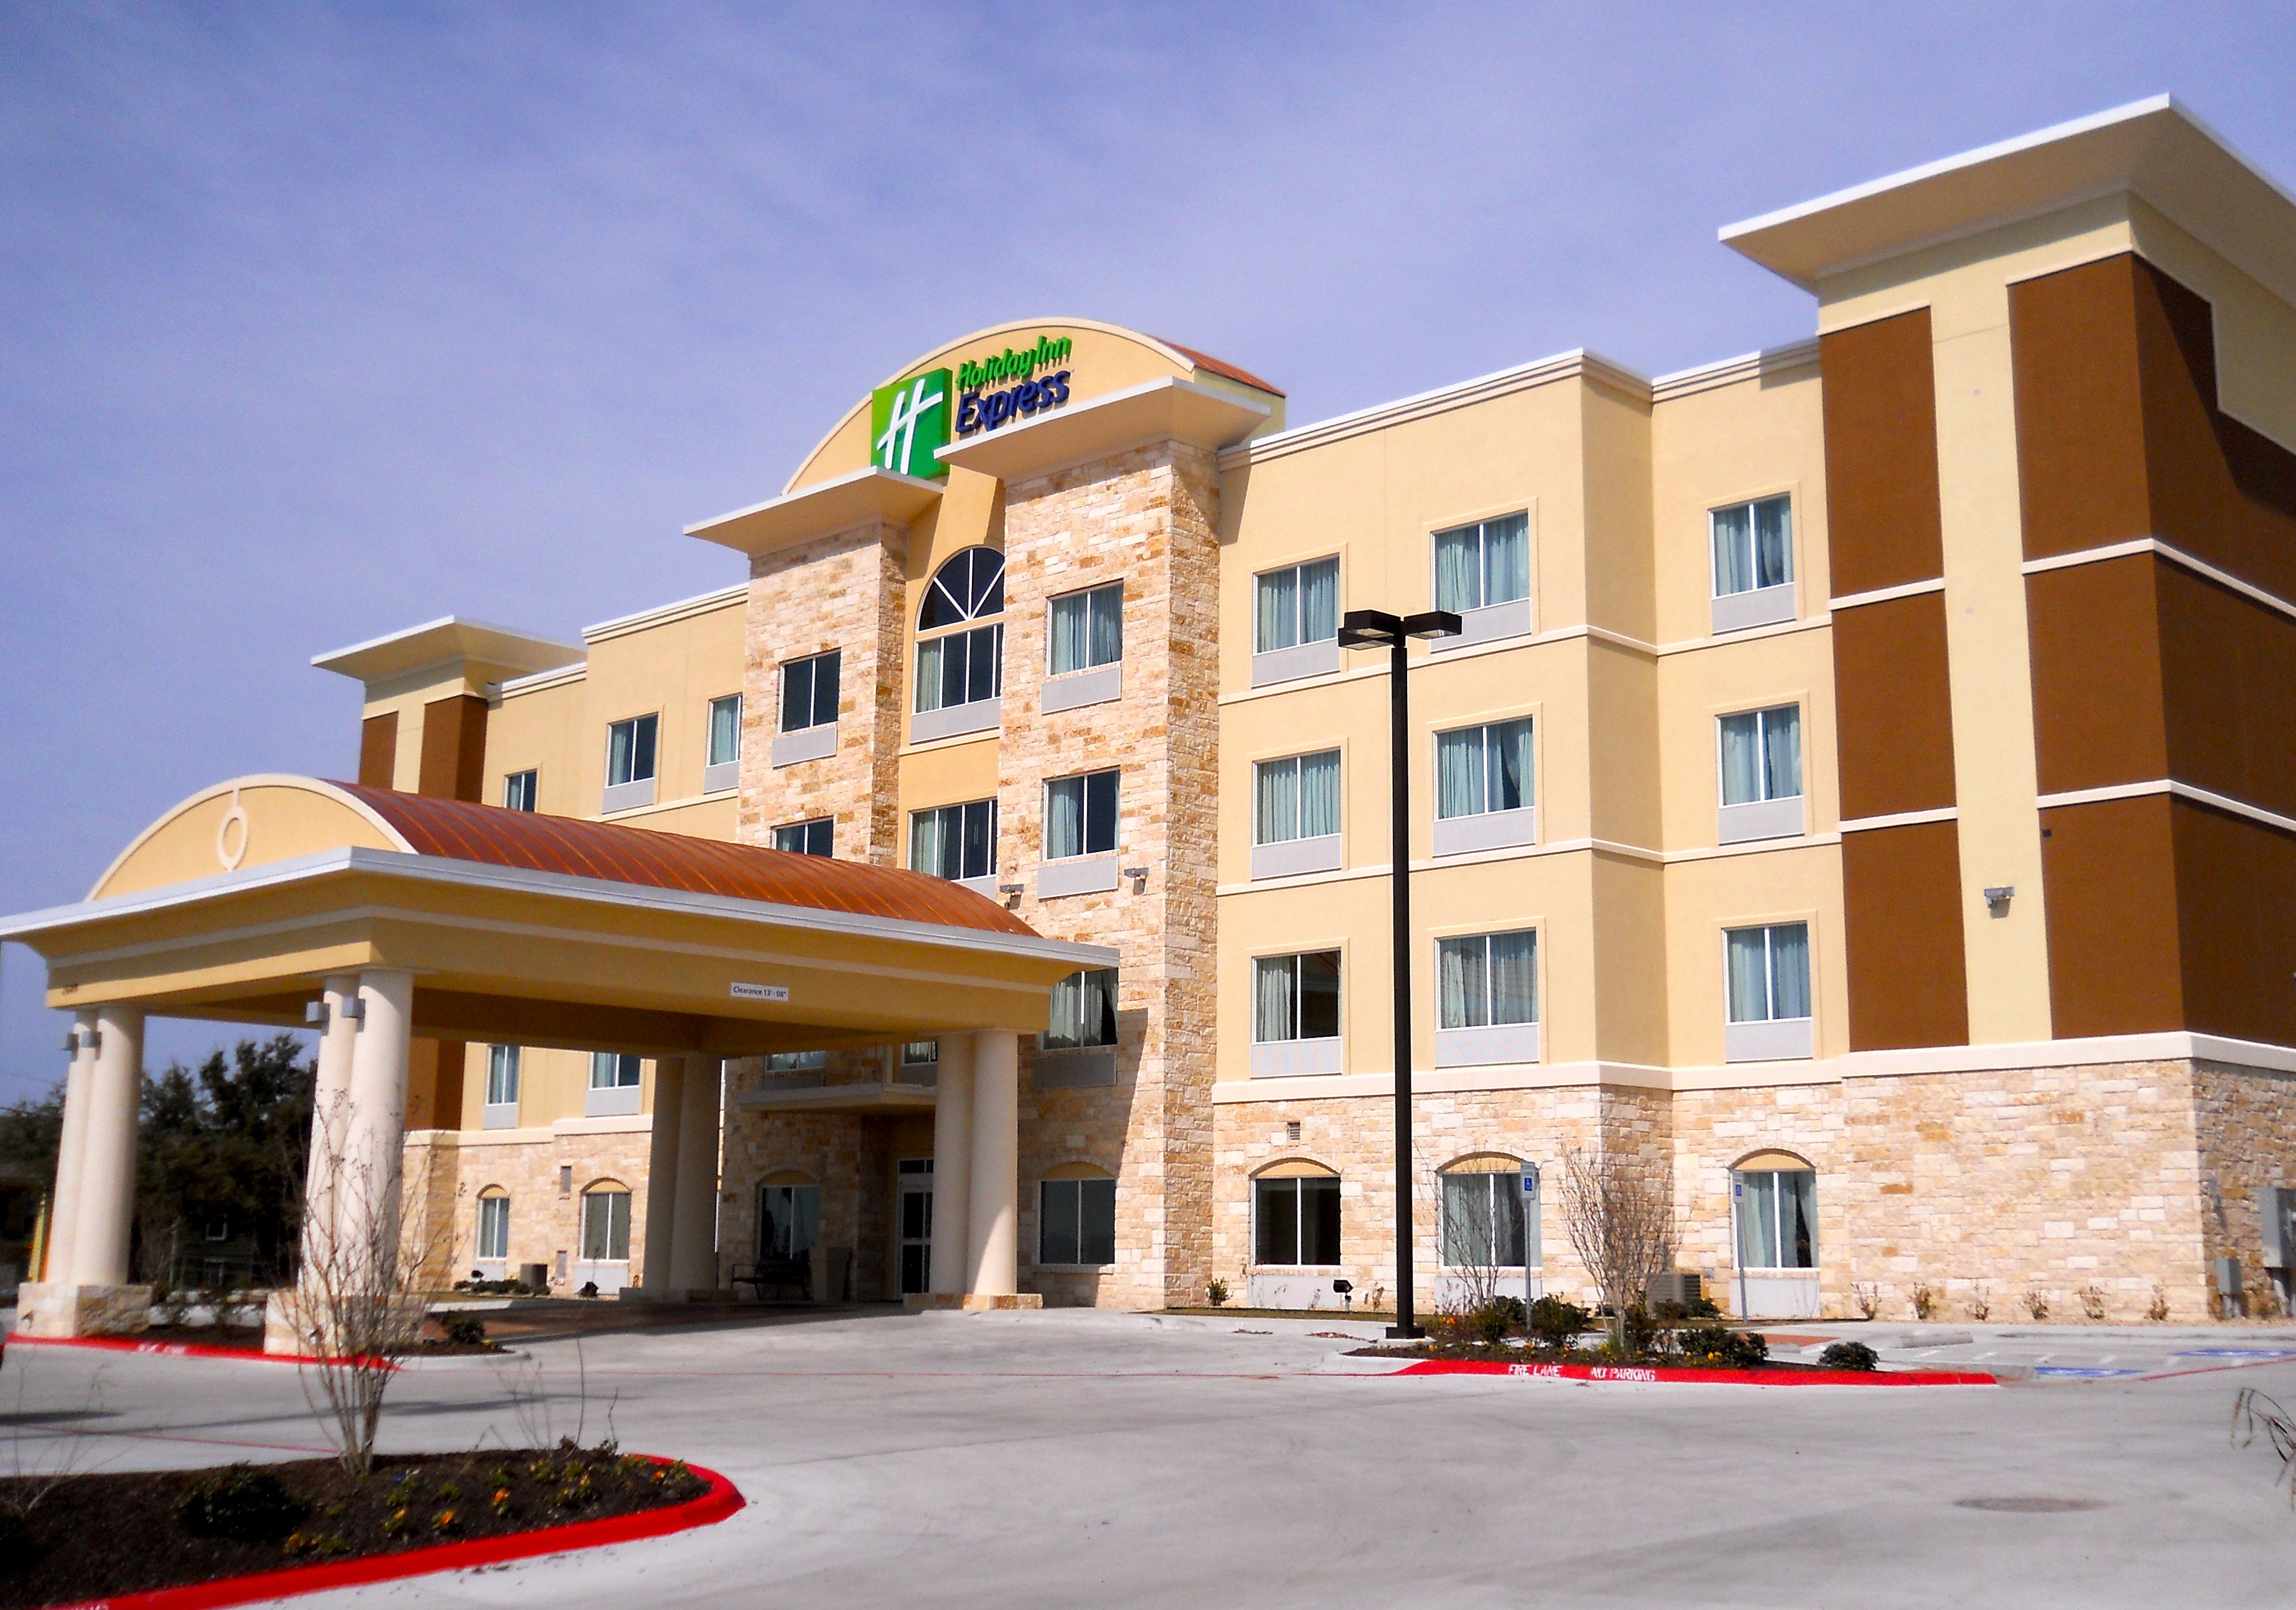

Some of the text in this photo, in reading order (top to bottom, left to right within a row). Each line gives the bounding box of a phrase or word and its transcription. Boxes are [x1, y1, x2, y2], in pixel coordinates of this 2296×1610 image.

[956, 336, 1073, 391] Holiday Inn
[955, 370, 1071, 433] Express
[733, 986, 763, 995] Clearance
[1508, 1364, 1563, 1377] FIRE LANE
[1591, 1367, 1656, 1381] NO PARKING
